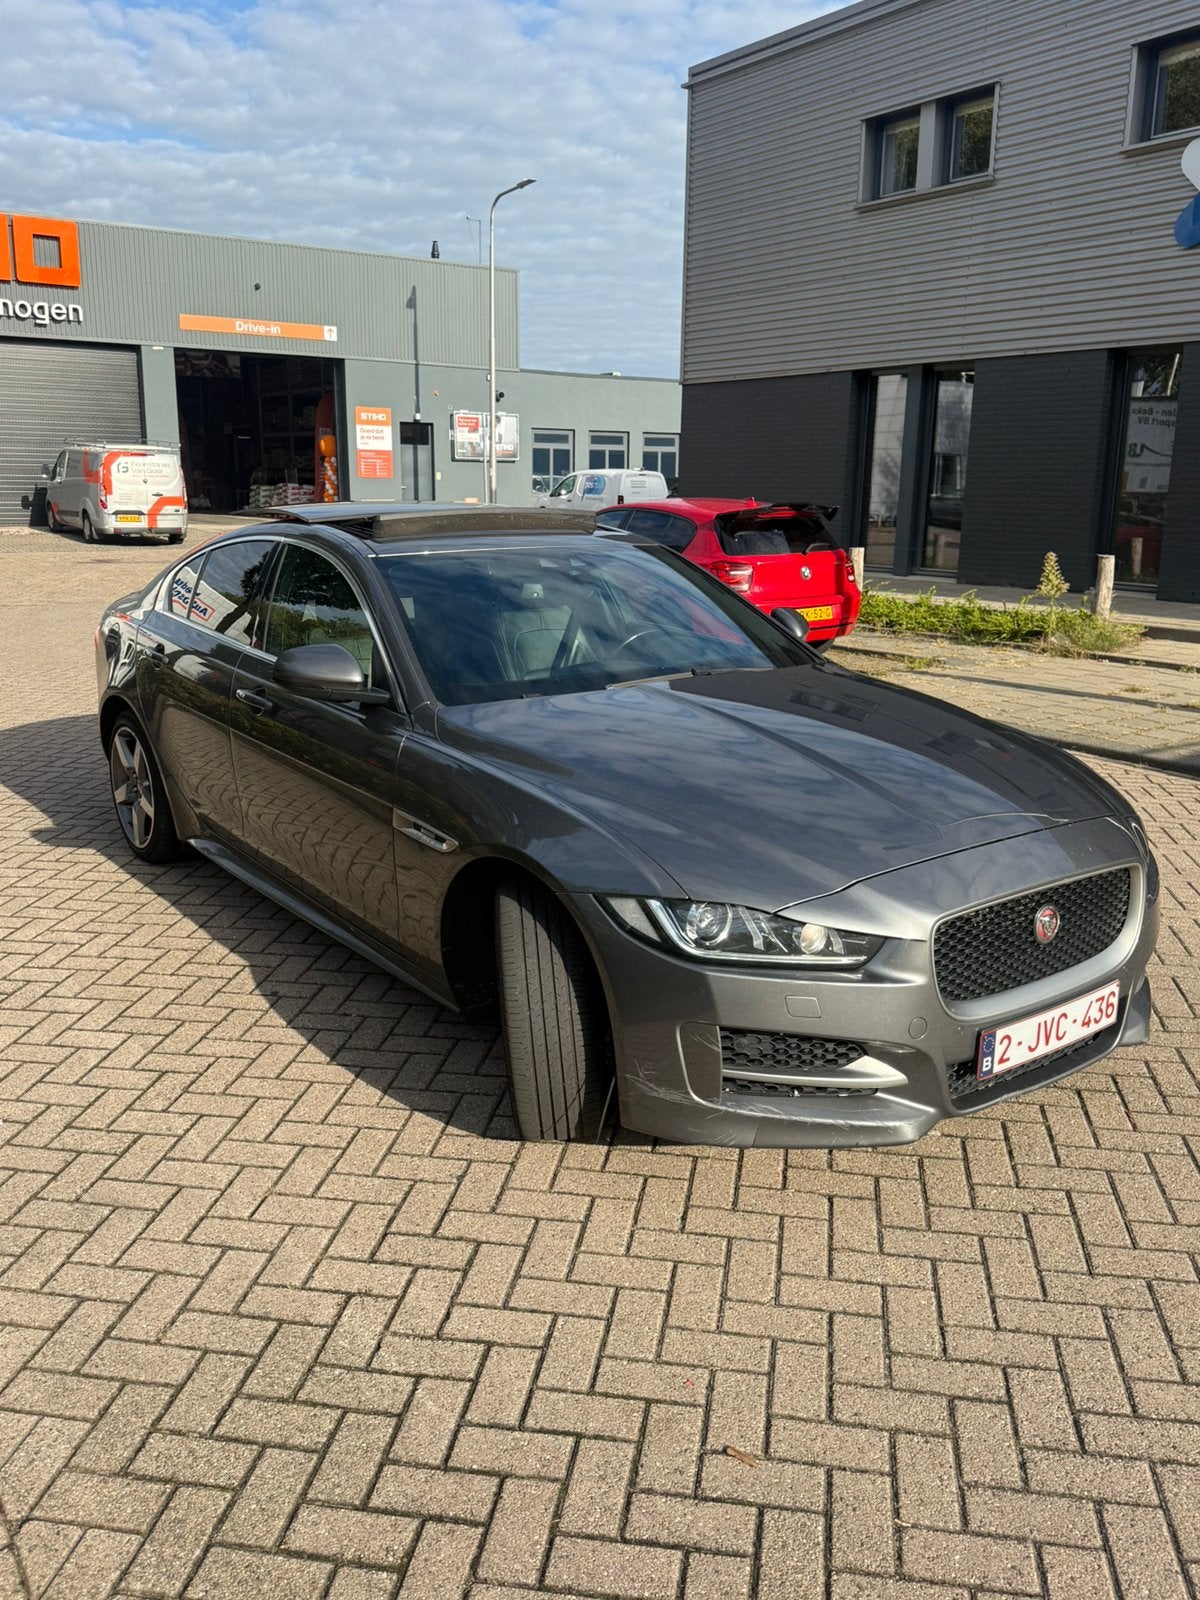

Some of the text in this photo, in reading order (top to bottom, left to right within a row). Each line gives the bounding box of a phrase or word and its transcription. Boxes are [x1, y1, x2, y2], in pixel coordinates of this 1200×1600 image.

[235, 321, 281, 335] Drive-in
[997, 991, 1116, 1065] 2-JVC-436
[982, 1056, 992, 1072] B
